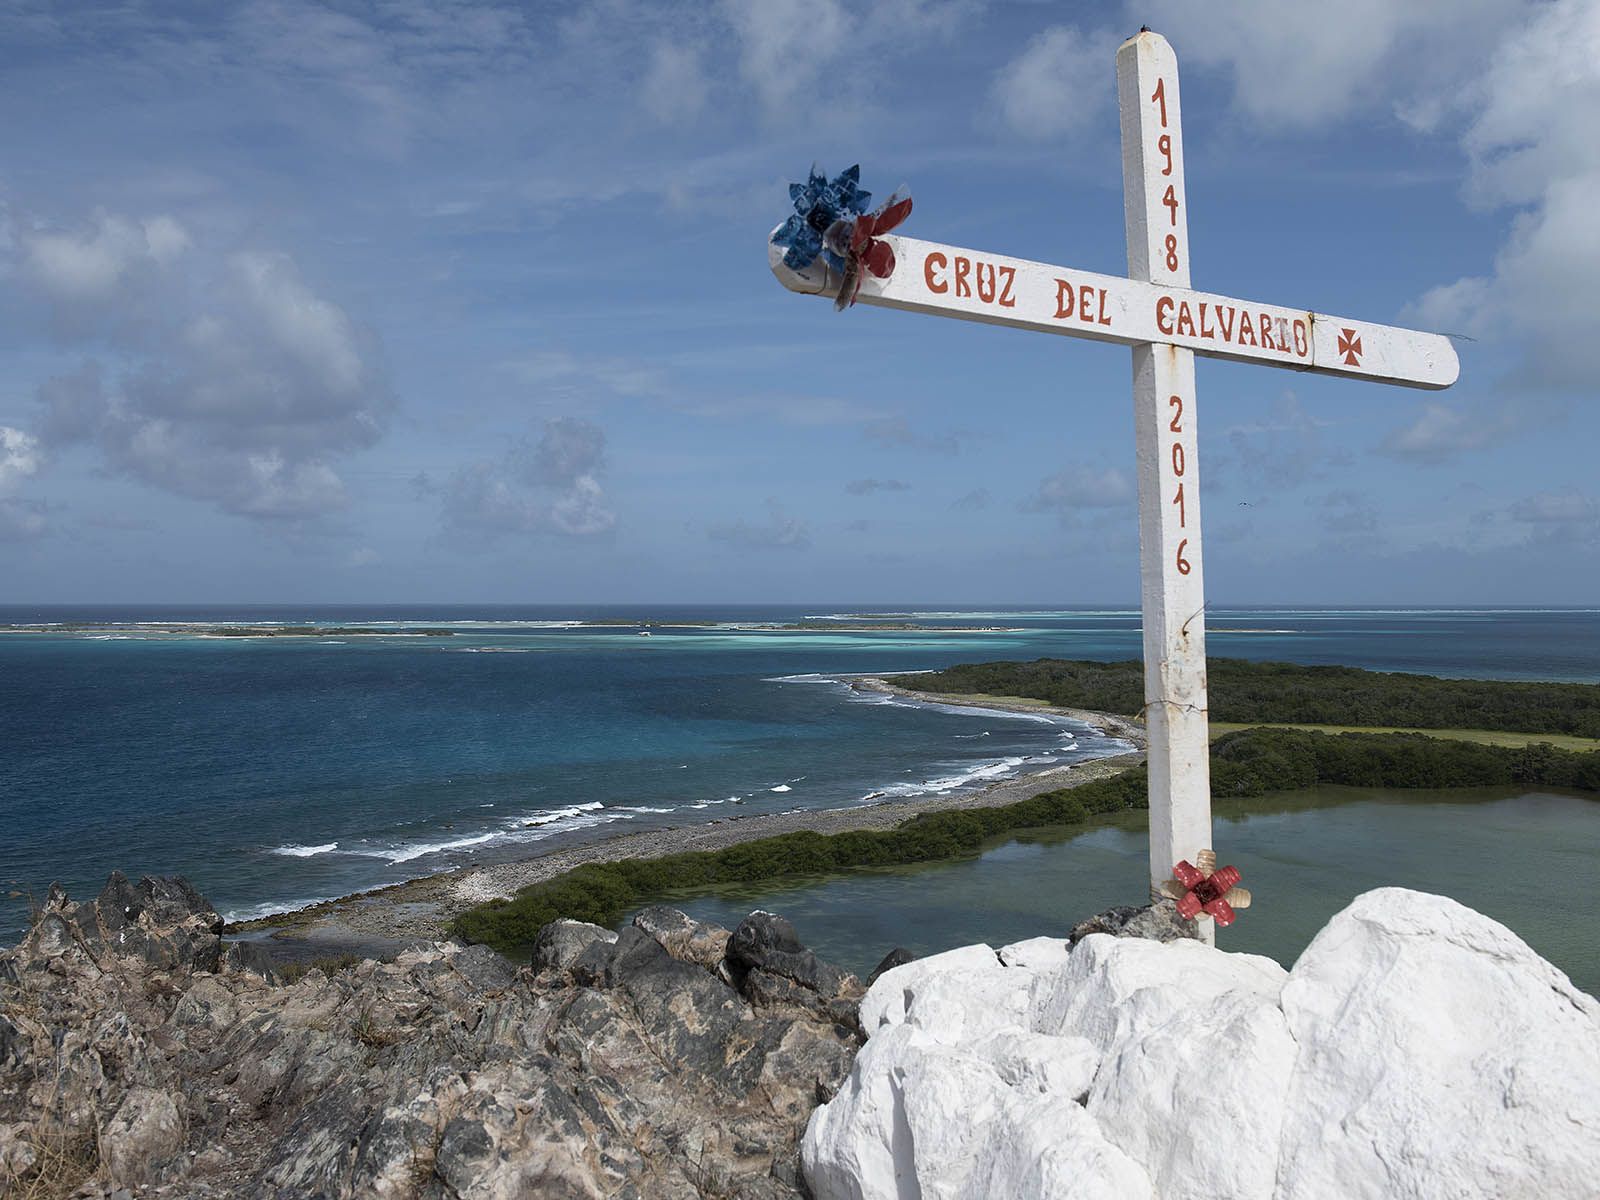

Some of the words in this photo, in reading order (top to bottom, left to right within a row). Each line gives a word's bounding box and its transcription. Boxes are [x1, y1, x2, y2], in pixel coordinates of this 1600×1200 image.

[1151, 79, 1179, 273] 1948
[924, 251, 1016, 308] CRUZ
[1054, 278, 1112, 326] DEL
[1155, 295, 1308, 358] CALVARIO
[1169, 395, 1191, 576] 2016
